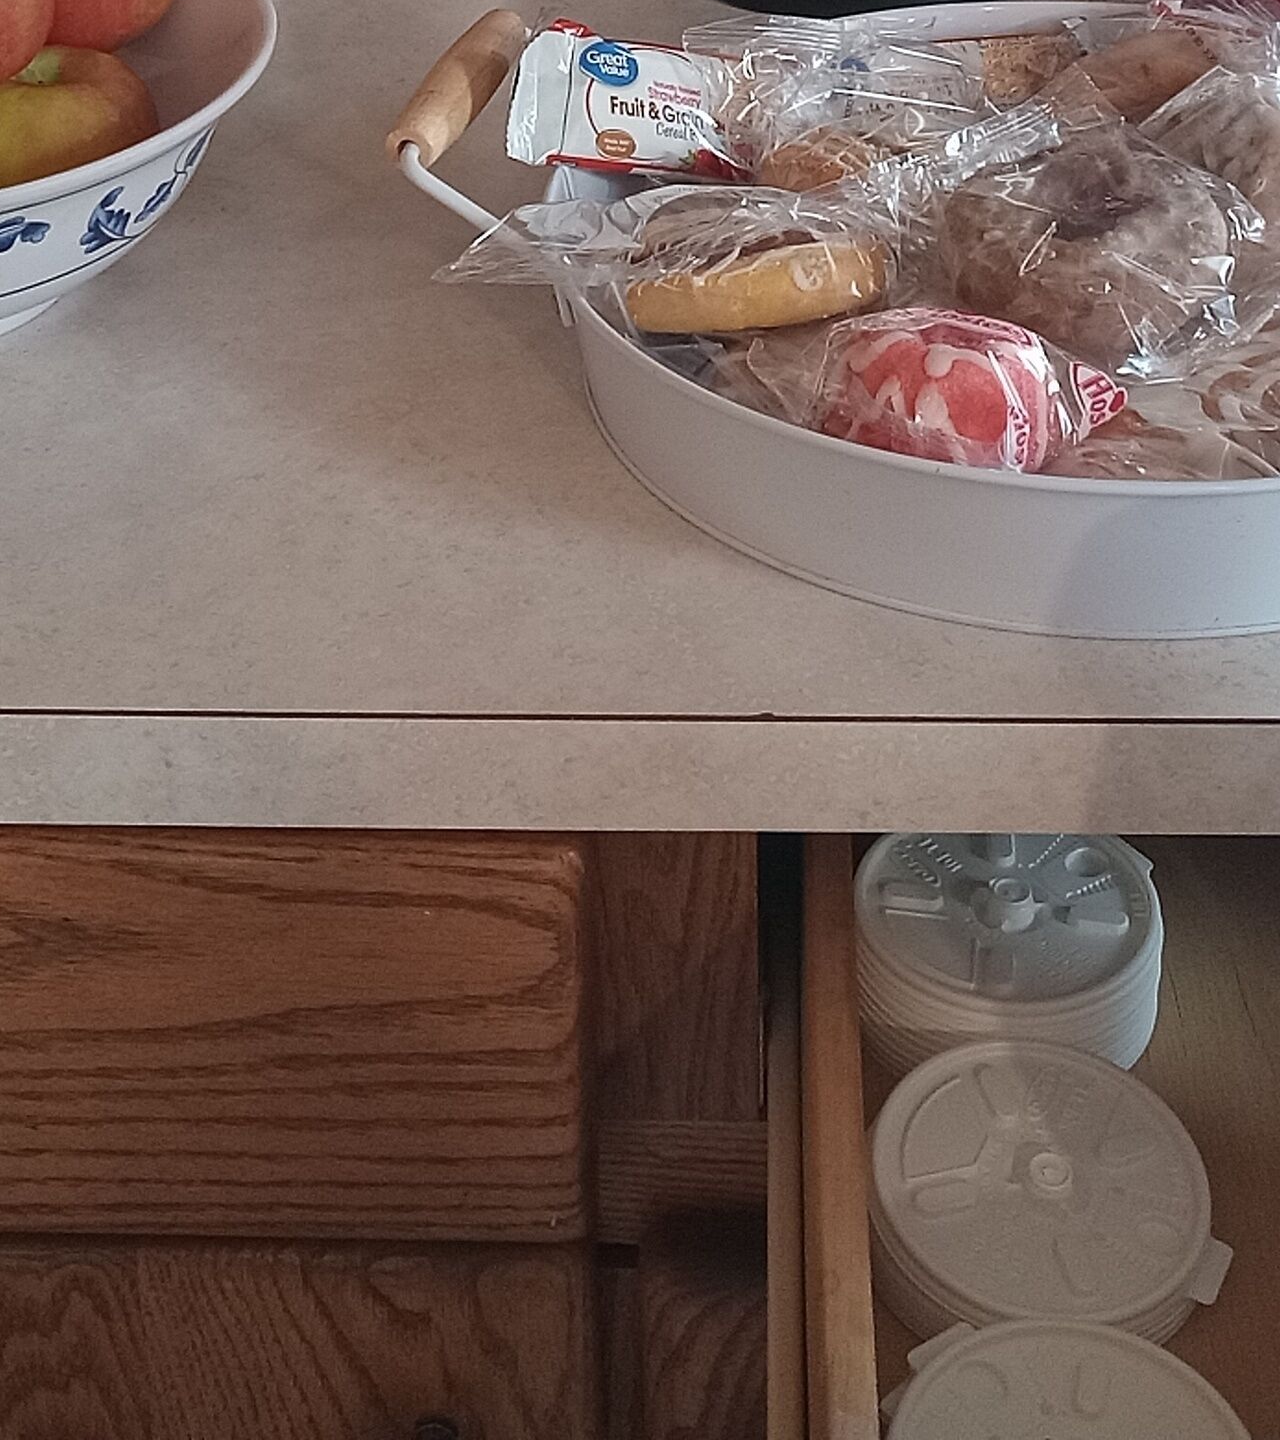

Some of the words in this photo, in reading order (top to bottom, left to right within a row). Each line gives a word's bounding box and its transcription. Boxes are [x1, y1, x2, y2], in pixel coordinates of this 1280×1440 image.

[586, 50, 629, 68] Great
[599, 63, 630, 77] Value
[647, 86, 702, 109] Strawberry
[609, 95, 645, 119] Fruit
[648, 101, 661, 121] &
